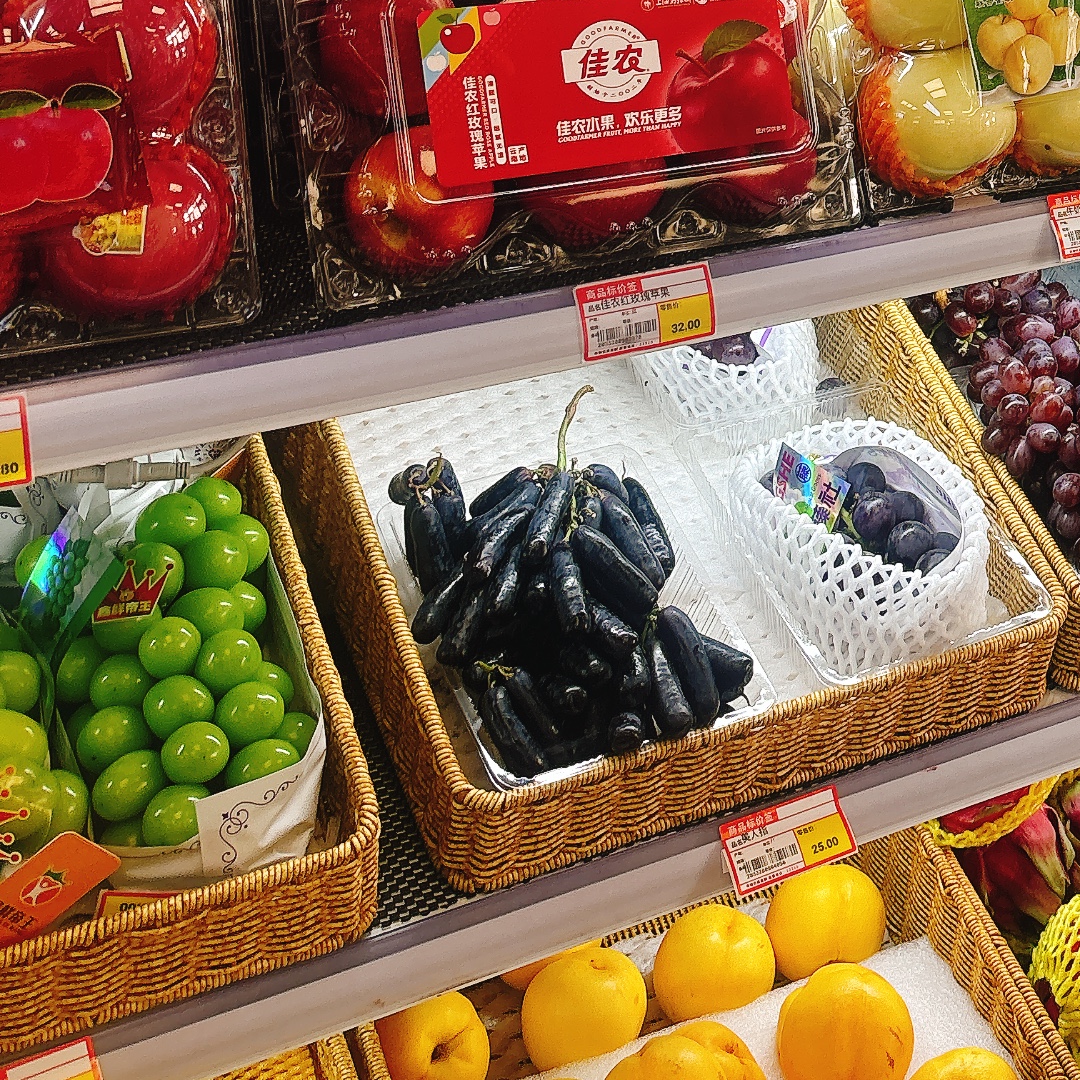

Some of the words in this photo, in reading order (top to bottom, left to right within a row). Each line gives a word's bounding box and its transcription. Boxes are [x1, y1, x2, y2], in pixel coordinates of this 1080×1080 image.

[578, 43, 647, 80] 佳农
[462, 75, 488, 170] 佳农红玫瑰苹果
[586, 281, 638, 300] 商品标价签
[671, 318, 701, 334] 32.00
[726, 810, 774, 838] 商品标价签
[811, 835, 840, 855] 25.00
